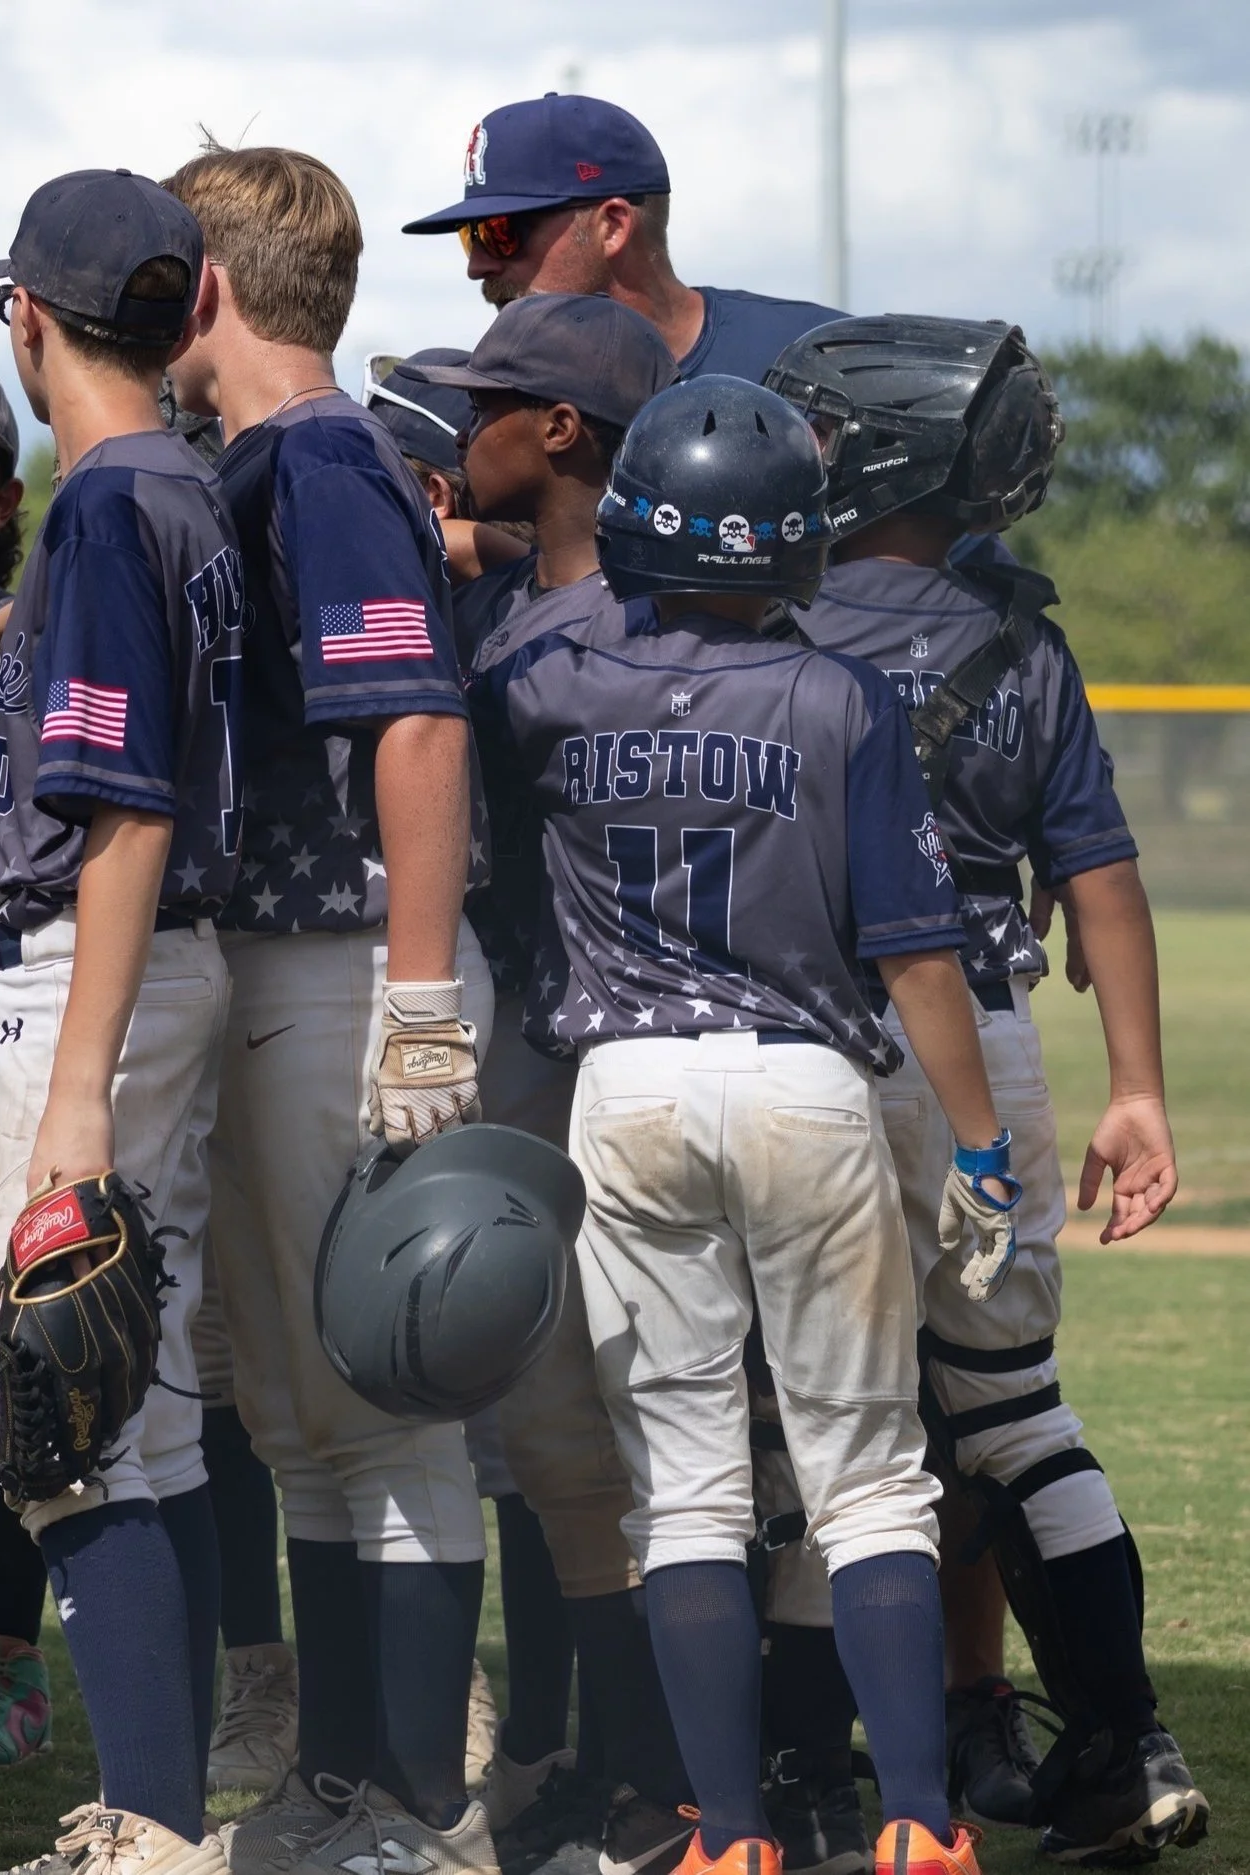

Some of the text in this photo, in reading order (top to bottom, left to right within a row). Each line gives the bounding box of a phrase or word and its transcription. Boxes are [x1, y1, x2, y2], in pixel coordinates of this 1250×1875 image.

[833, 507, 858, 528] PRO
[562, 730, 801, 821] RISTOW
[605, 824, 752, 982] 11
[406, 1050, 448, 1070] Rawlings
[18, 1205, 74, 1253] Rawlings
